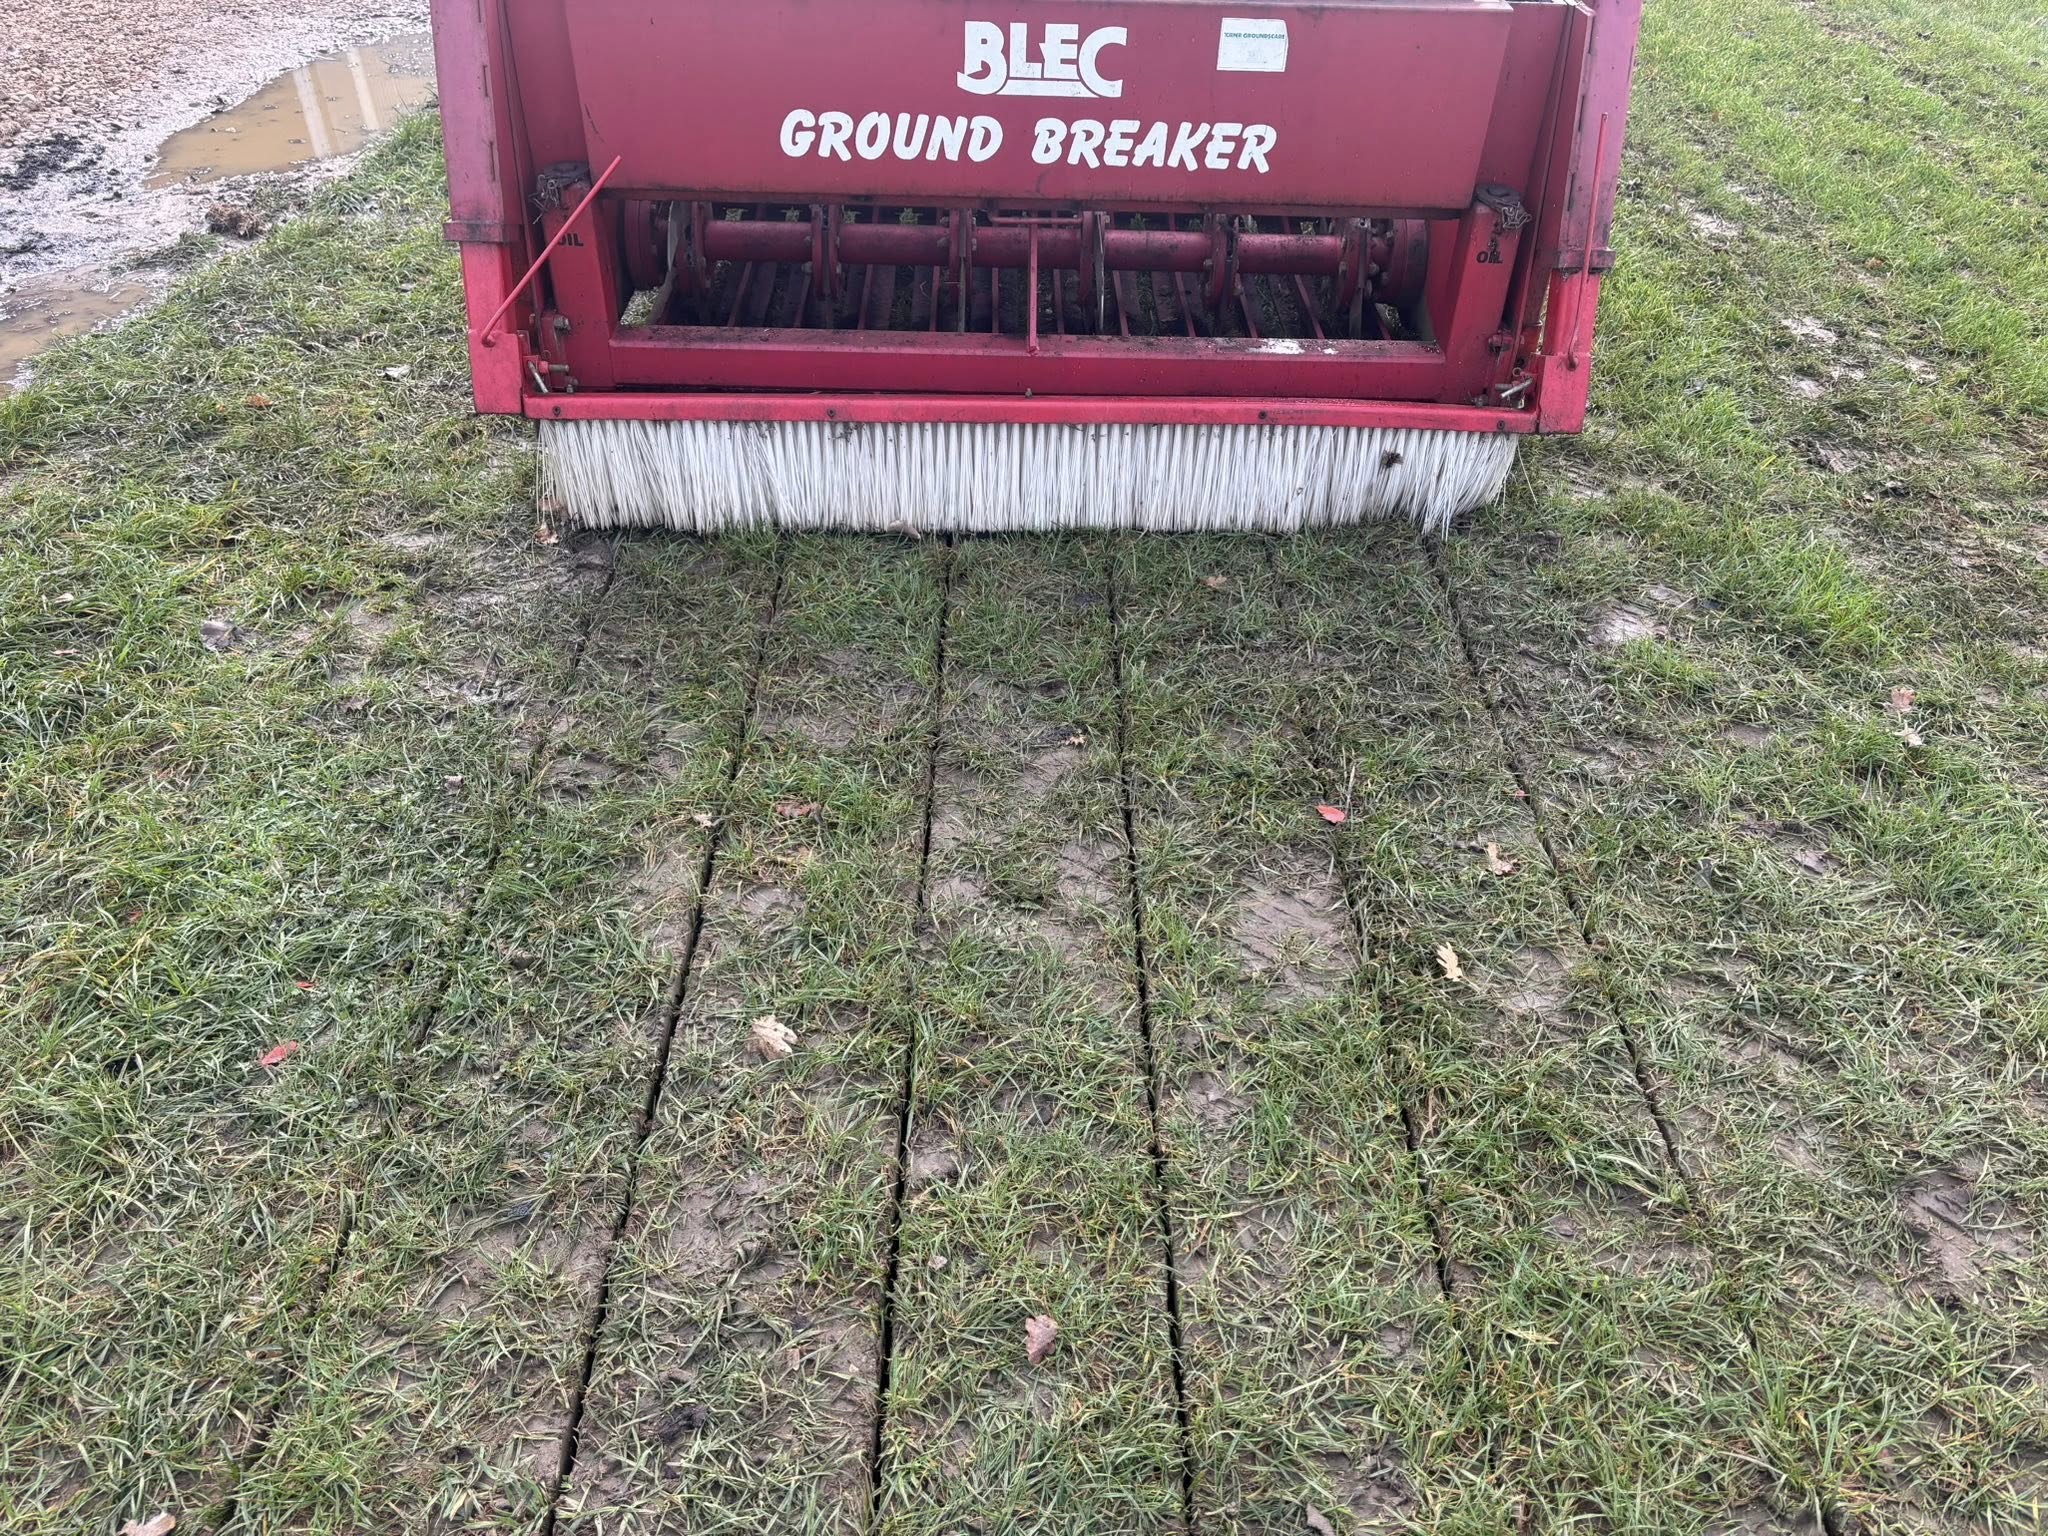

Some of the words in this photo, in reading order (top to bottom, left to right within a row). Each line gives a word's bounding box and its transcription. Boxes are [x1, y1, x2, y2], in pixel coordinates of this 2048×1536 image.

[957, 21, 1127, 97] BLEC
[780, 109, 1004, 162] GROUND
[1031, 117, 1278, 173] BREAKER
[1476, 250, 1503, 264] OIL
